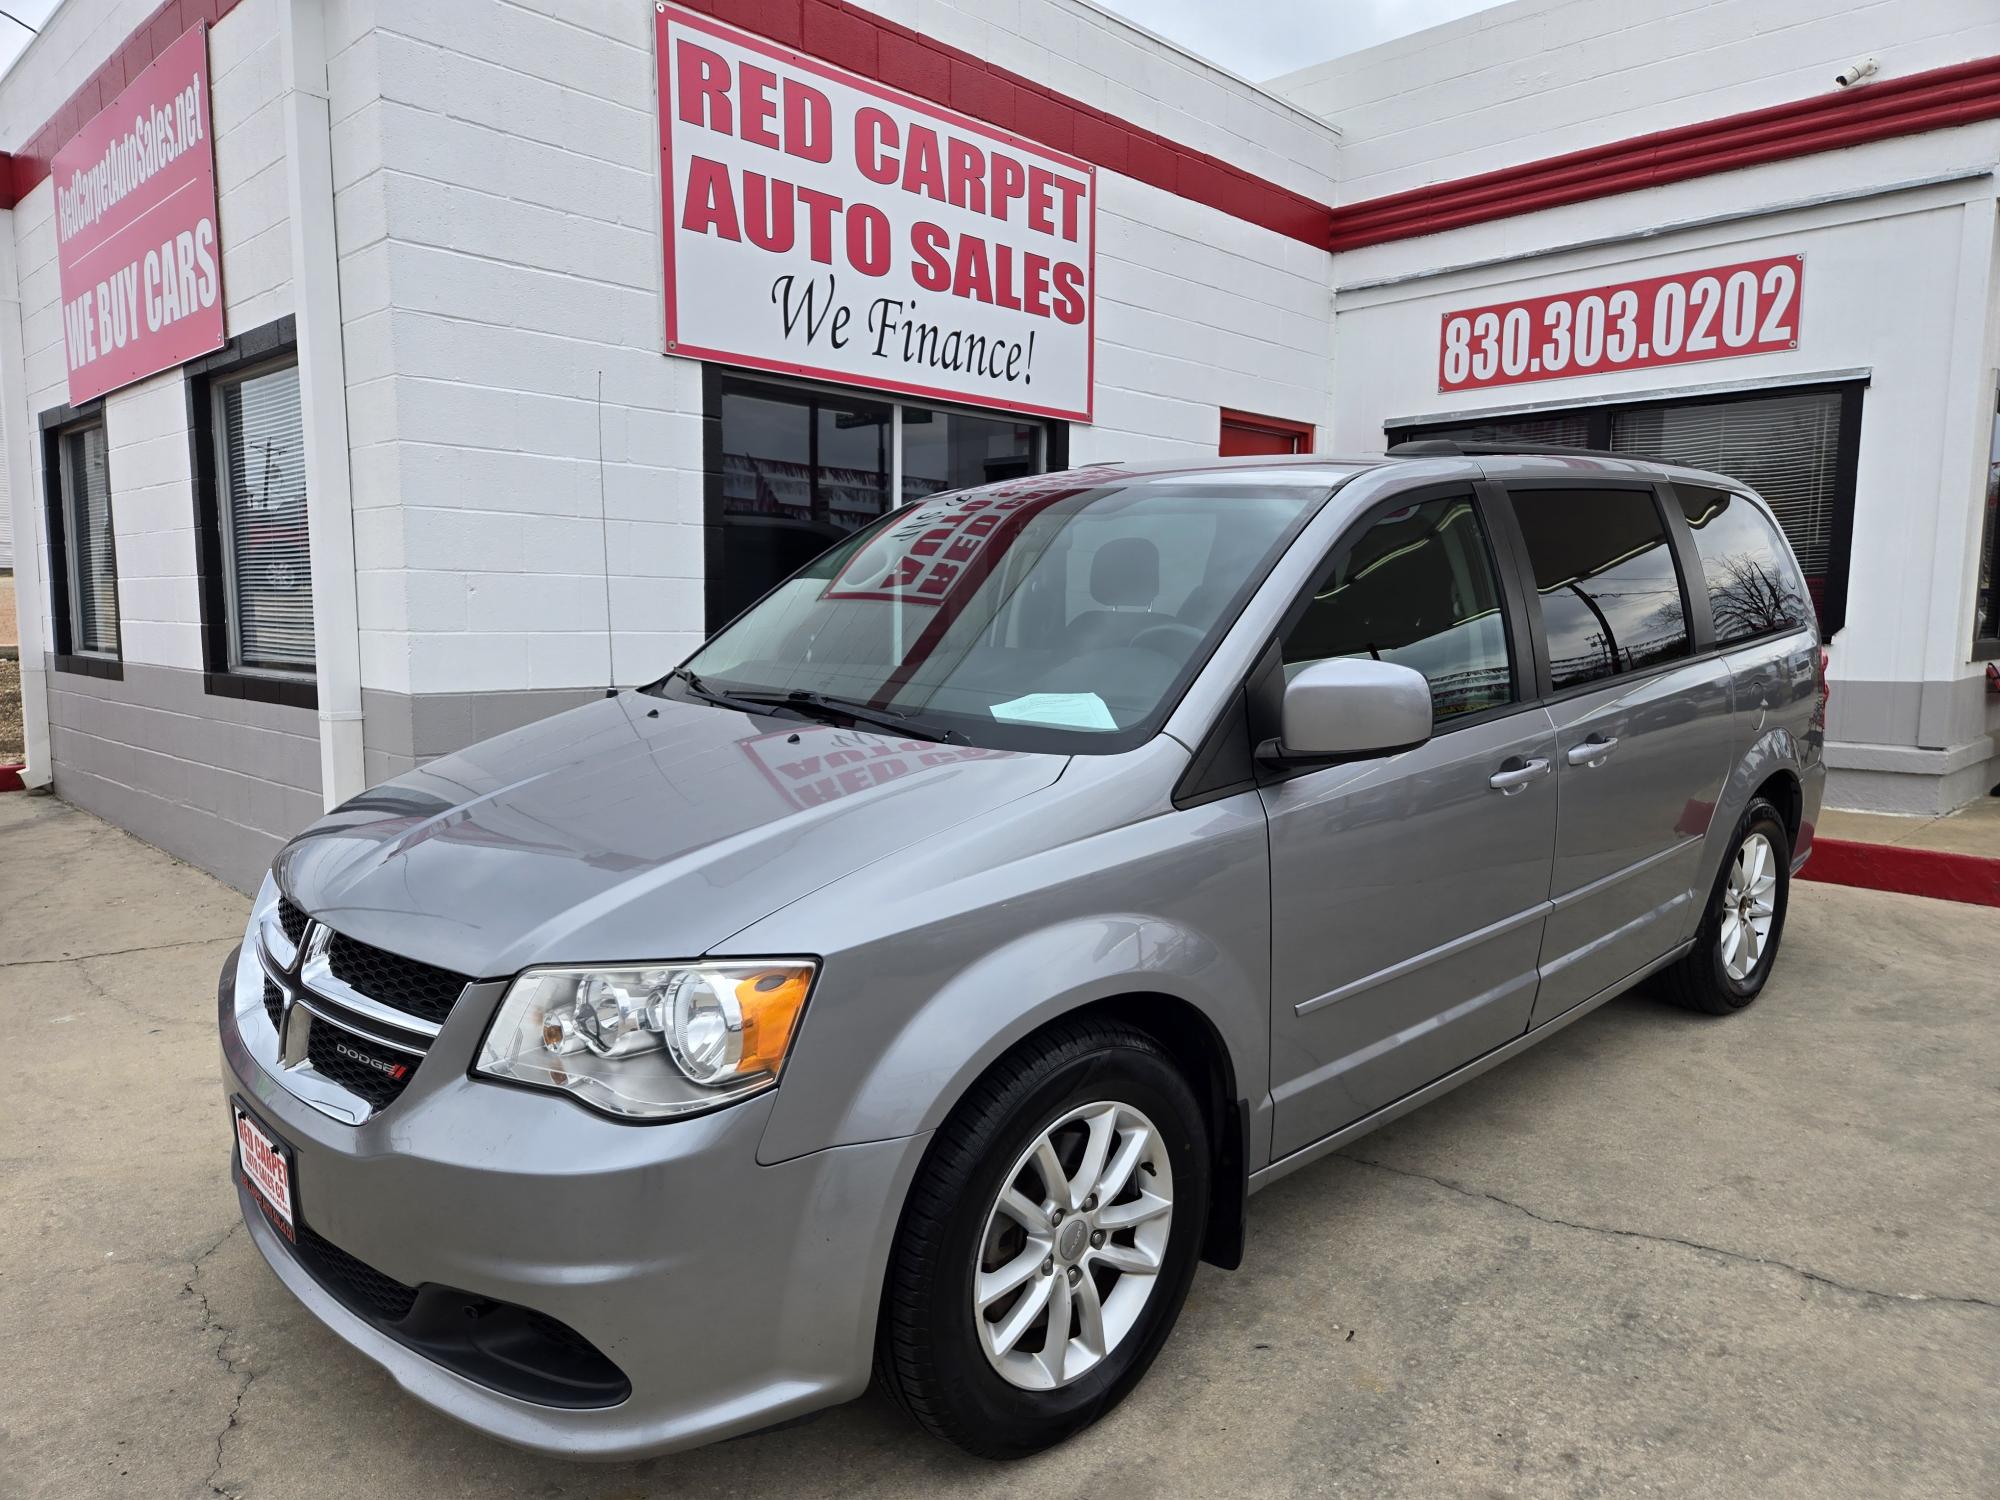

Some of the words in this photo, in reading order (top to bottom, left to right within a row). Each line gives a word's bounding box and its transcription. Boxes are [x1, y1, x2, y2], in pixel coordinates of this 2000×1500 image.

[57, 72, 204, 243] RedCarpetAutoSales.net
[676, 38, 833, 164] RED
[854, 106, 1086, 243] CARPET
[64, 291, 97, 371] WE
[100, 261, 141, 356] BUY
[143, 217, 218, 333] CARS
[681, 154, 891, 278] AUTO
[910, 221, 1086, 325] SALES
[771, 273, 852, 349] We
[868, 297, 1037, 386] Finance!
[1443, 264, 1796, 385] 830.303.0202
[336, 1043, 395, 1075] DODGE
[239, 1119, 254, 1152] RED
[255, 1135, 288, 1187] CARPET
